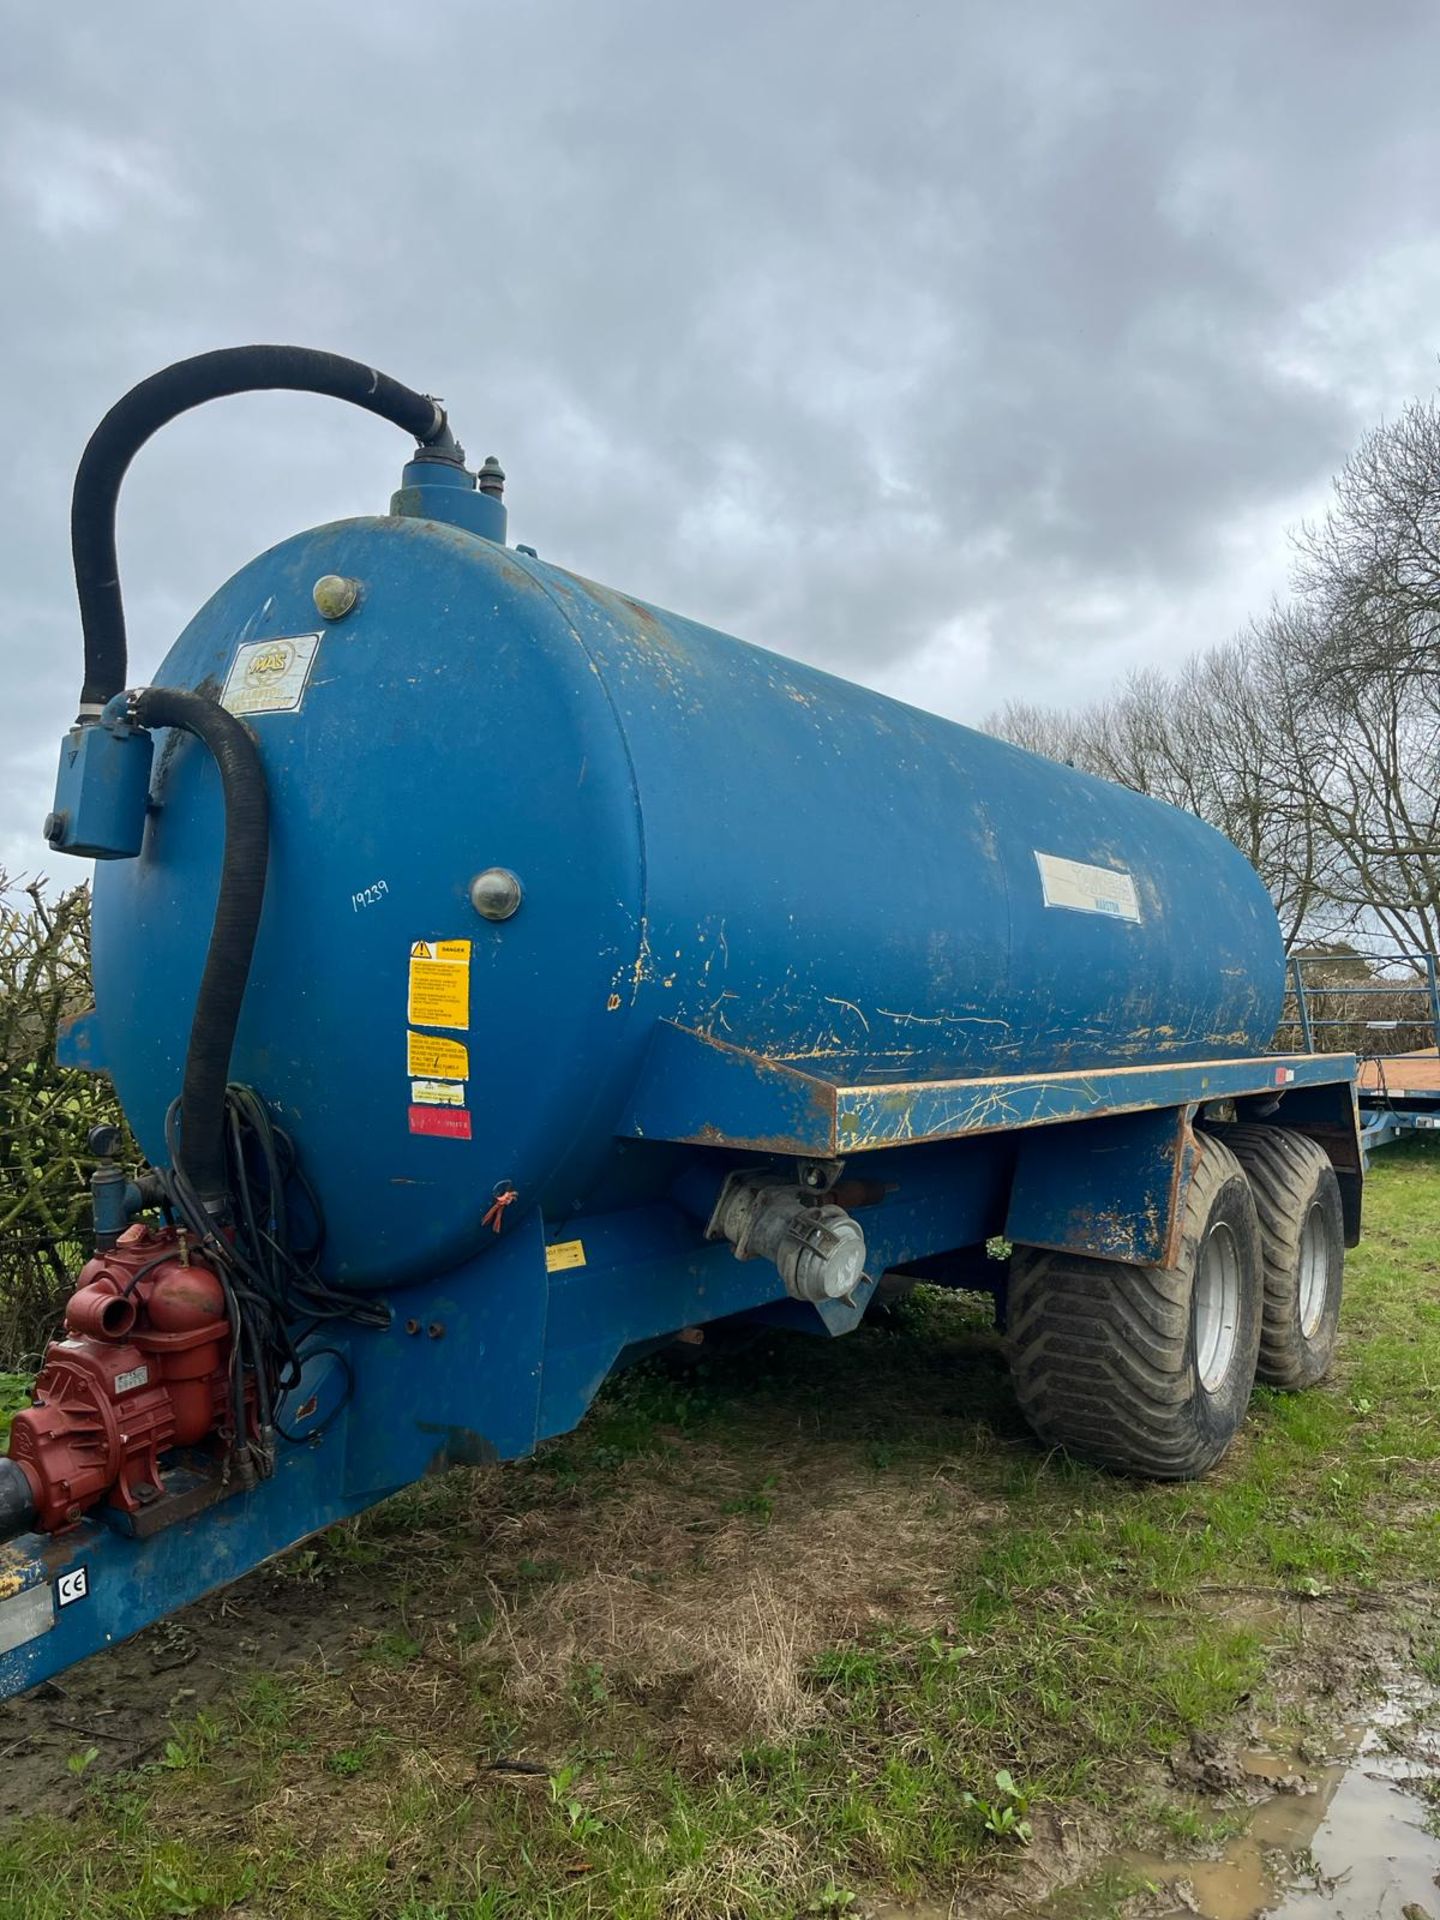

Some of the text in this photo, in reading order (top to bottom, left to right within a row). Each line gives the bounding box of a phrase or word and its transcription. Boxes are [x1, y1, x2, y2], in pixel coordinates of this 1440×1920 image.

[248, 652, 287, 674] MAS
[352, 880, 389, 912] 19239
[62, 1571, 85, 1597] CE
